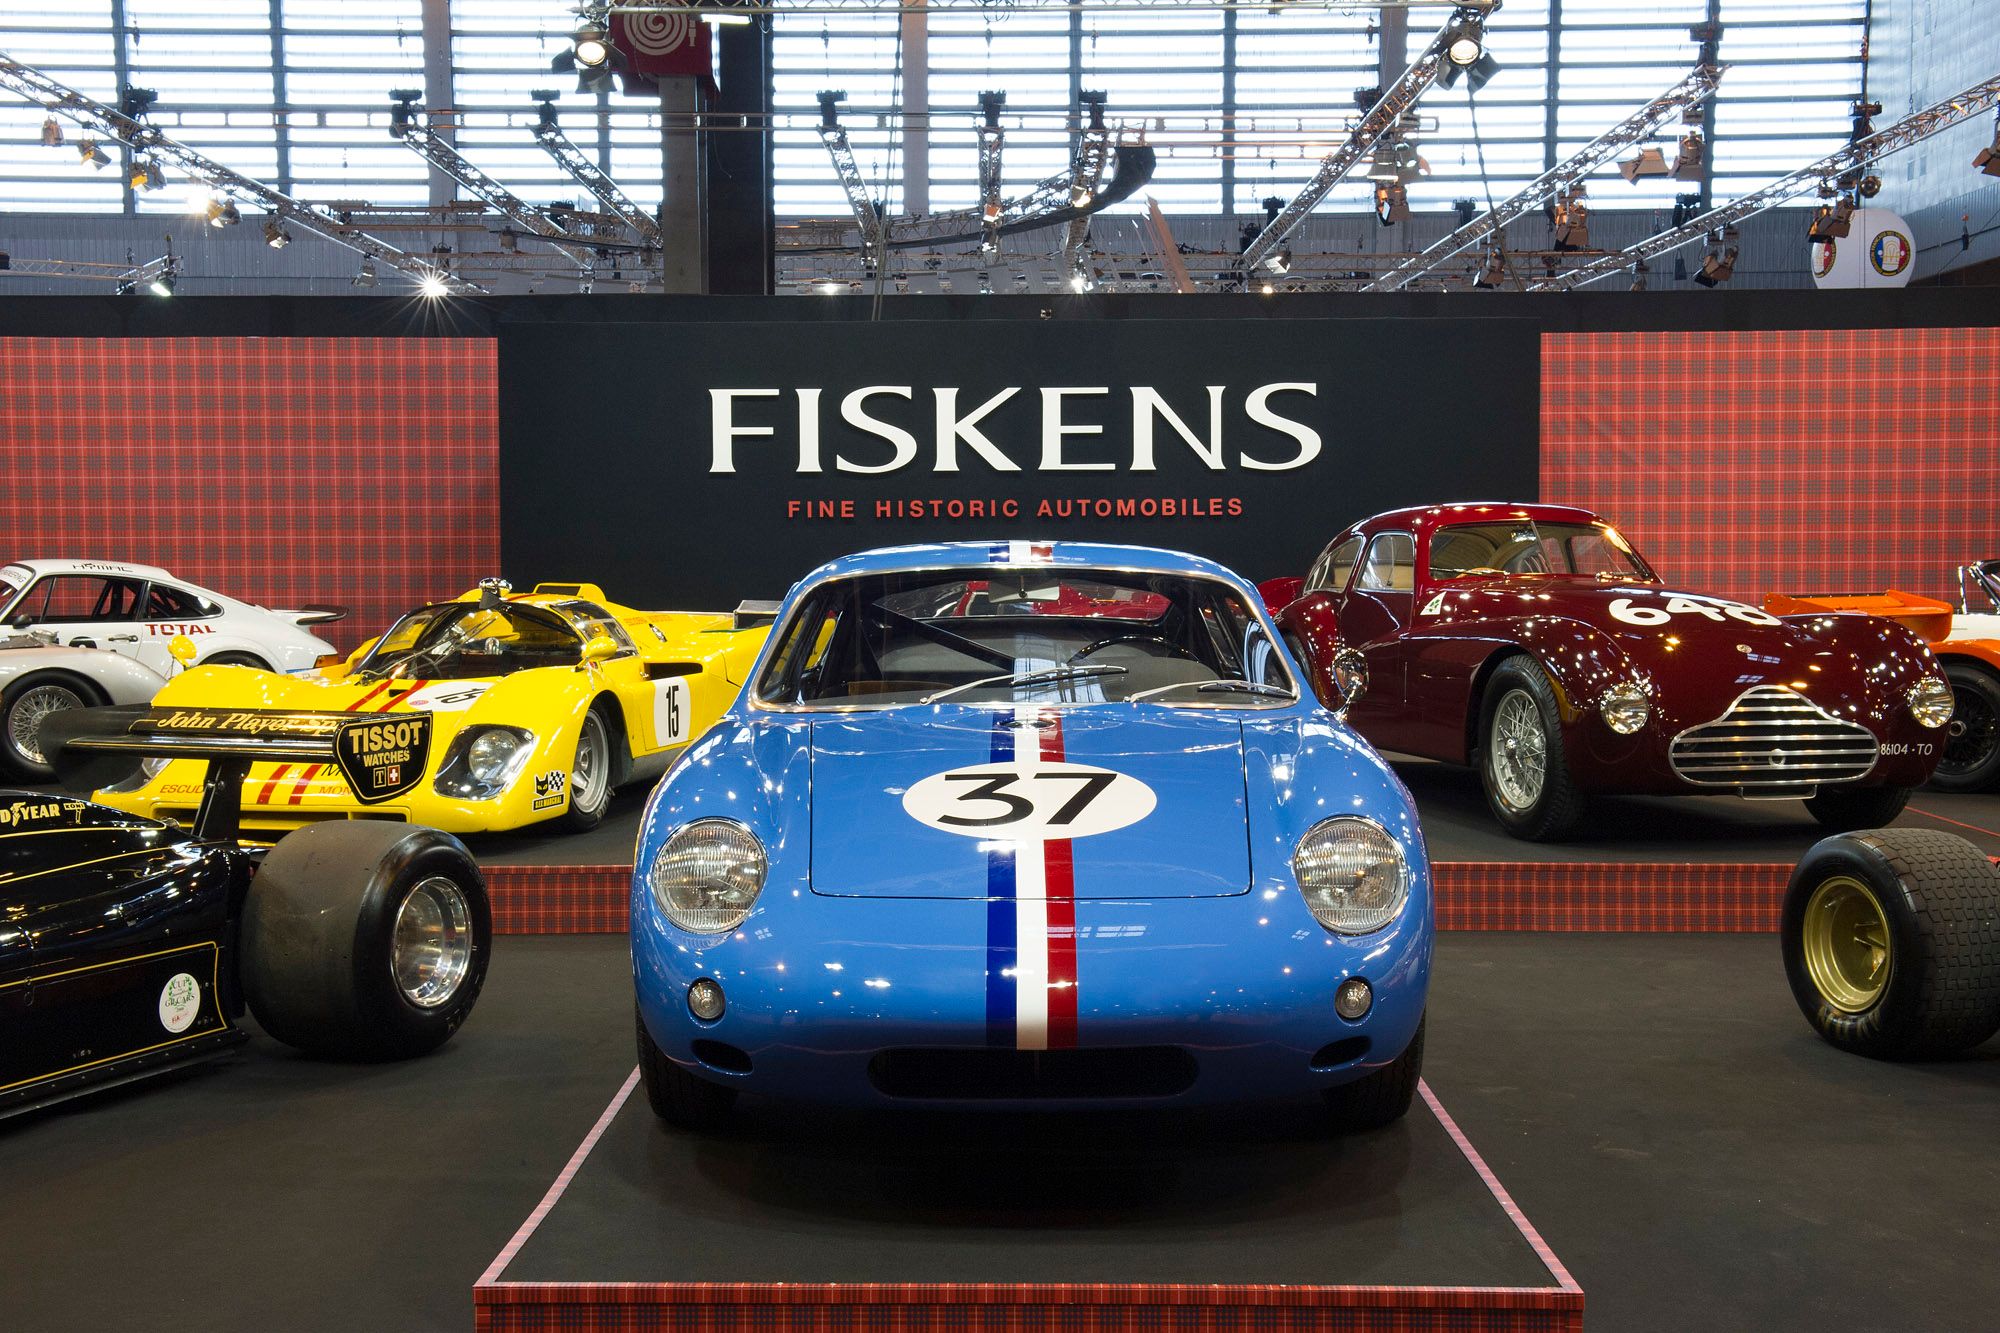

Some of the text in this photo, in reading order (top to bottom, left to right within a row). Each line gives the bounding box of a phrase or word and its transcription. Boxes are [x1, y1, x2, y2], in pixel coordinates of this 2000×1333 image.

[709, 382, 1323, 474] FISKENS
[787, 497, 1244, 519] FINE HISTORIC AUTOMOBILES
[145, 623, 217, 637] TOTAL
[157, 711, 214, 729] John
[217, 712, 300, 735] Player
[665, 684, 680, 739] 15
[348, 721, 423, 754] TISSOT
[363, 749, 410, 768] WATCHES
[1880, 743, 1909, 756] 86104
[1917, 743, 1933, 756] TO
[159, 783, 206, 794] ESCUD
[936, 772, 1118, 827] 37
